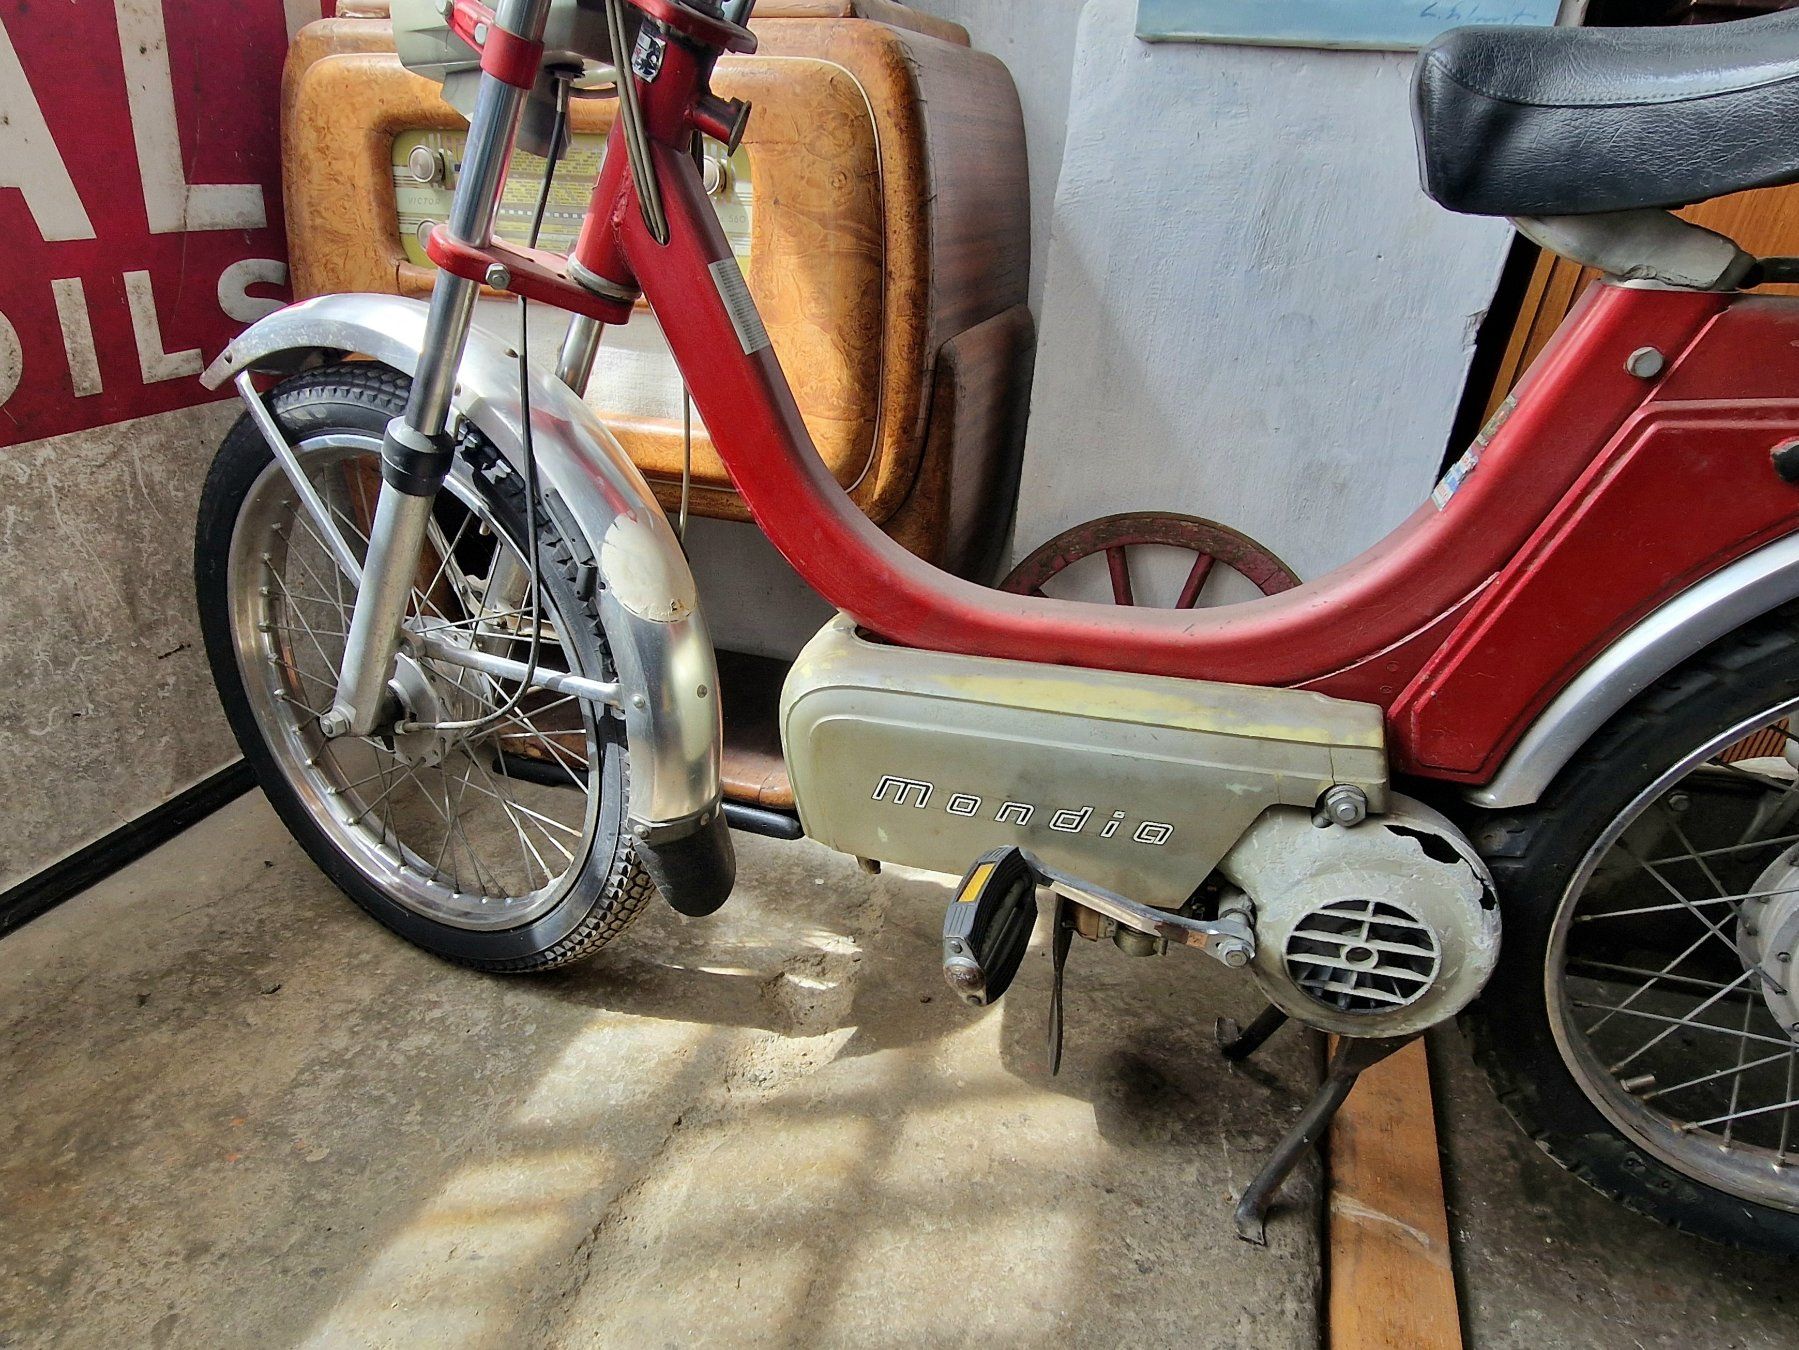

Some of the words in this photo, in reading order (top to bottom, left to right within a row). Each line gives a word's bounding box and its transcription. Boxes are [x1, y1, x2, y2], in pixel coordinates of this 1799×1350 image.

[408, 196, 441, 206] VICTOR
[0, 259, 288, 406] ILS
[872, 774, 1174, 846] mondia
